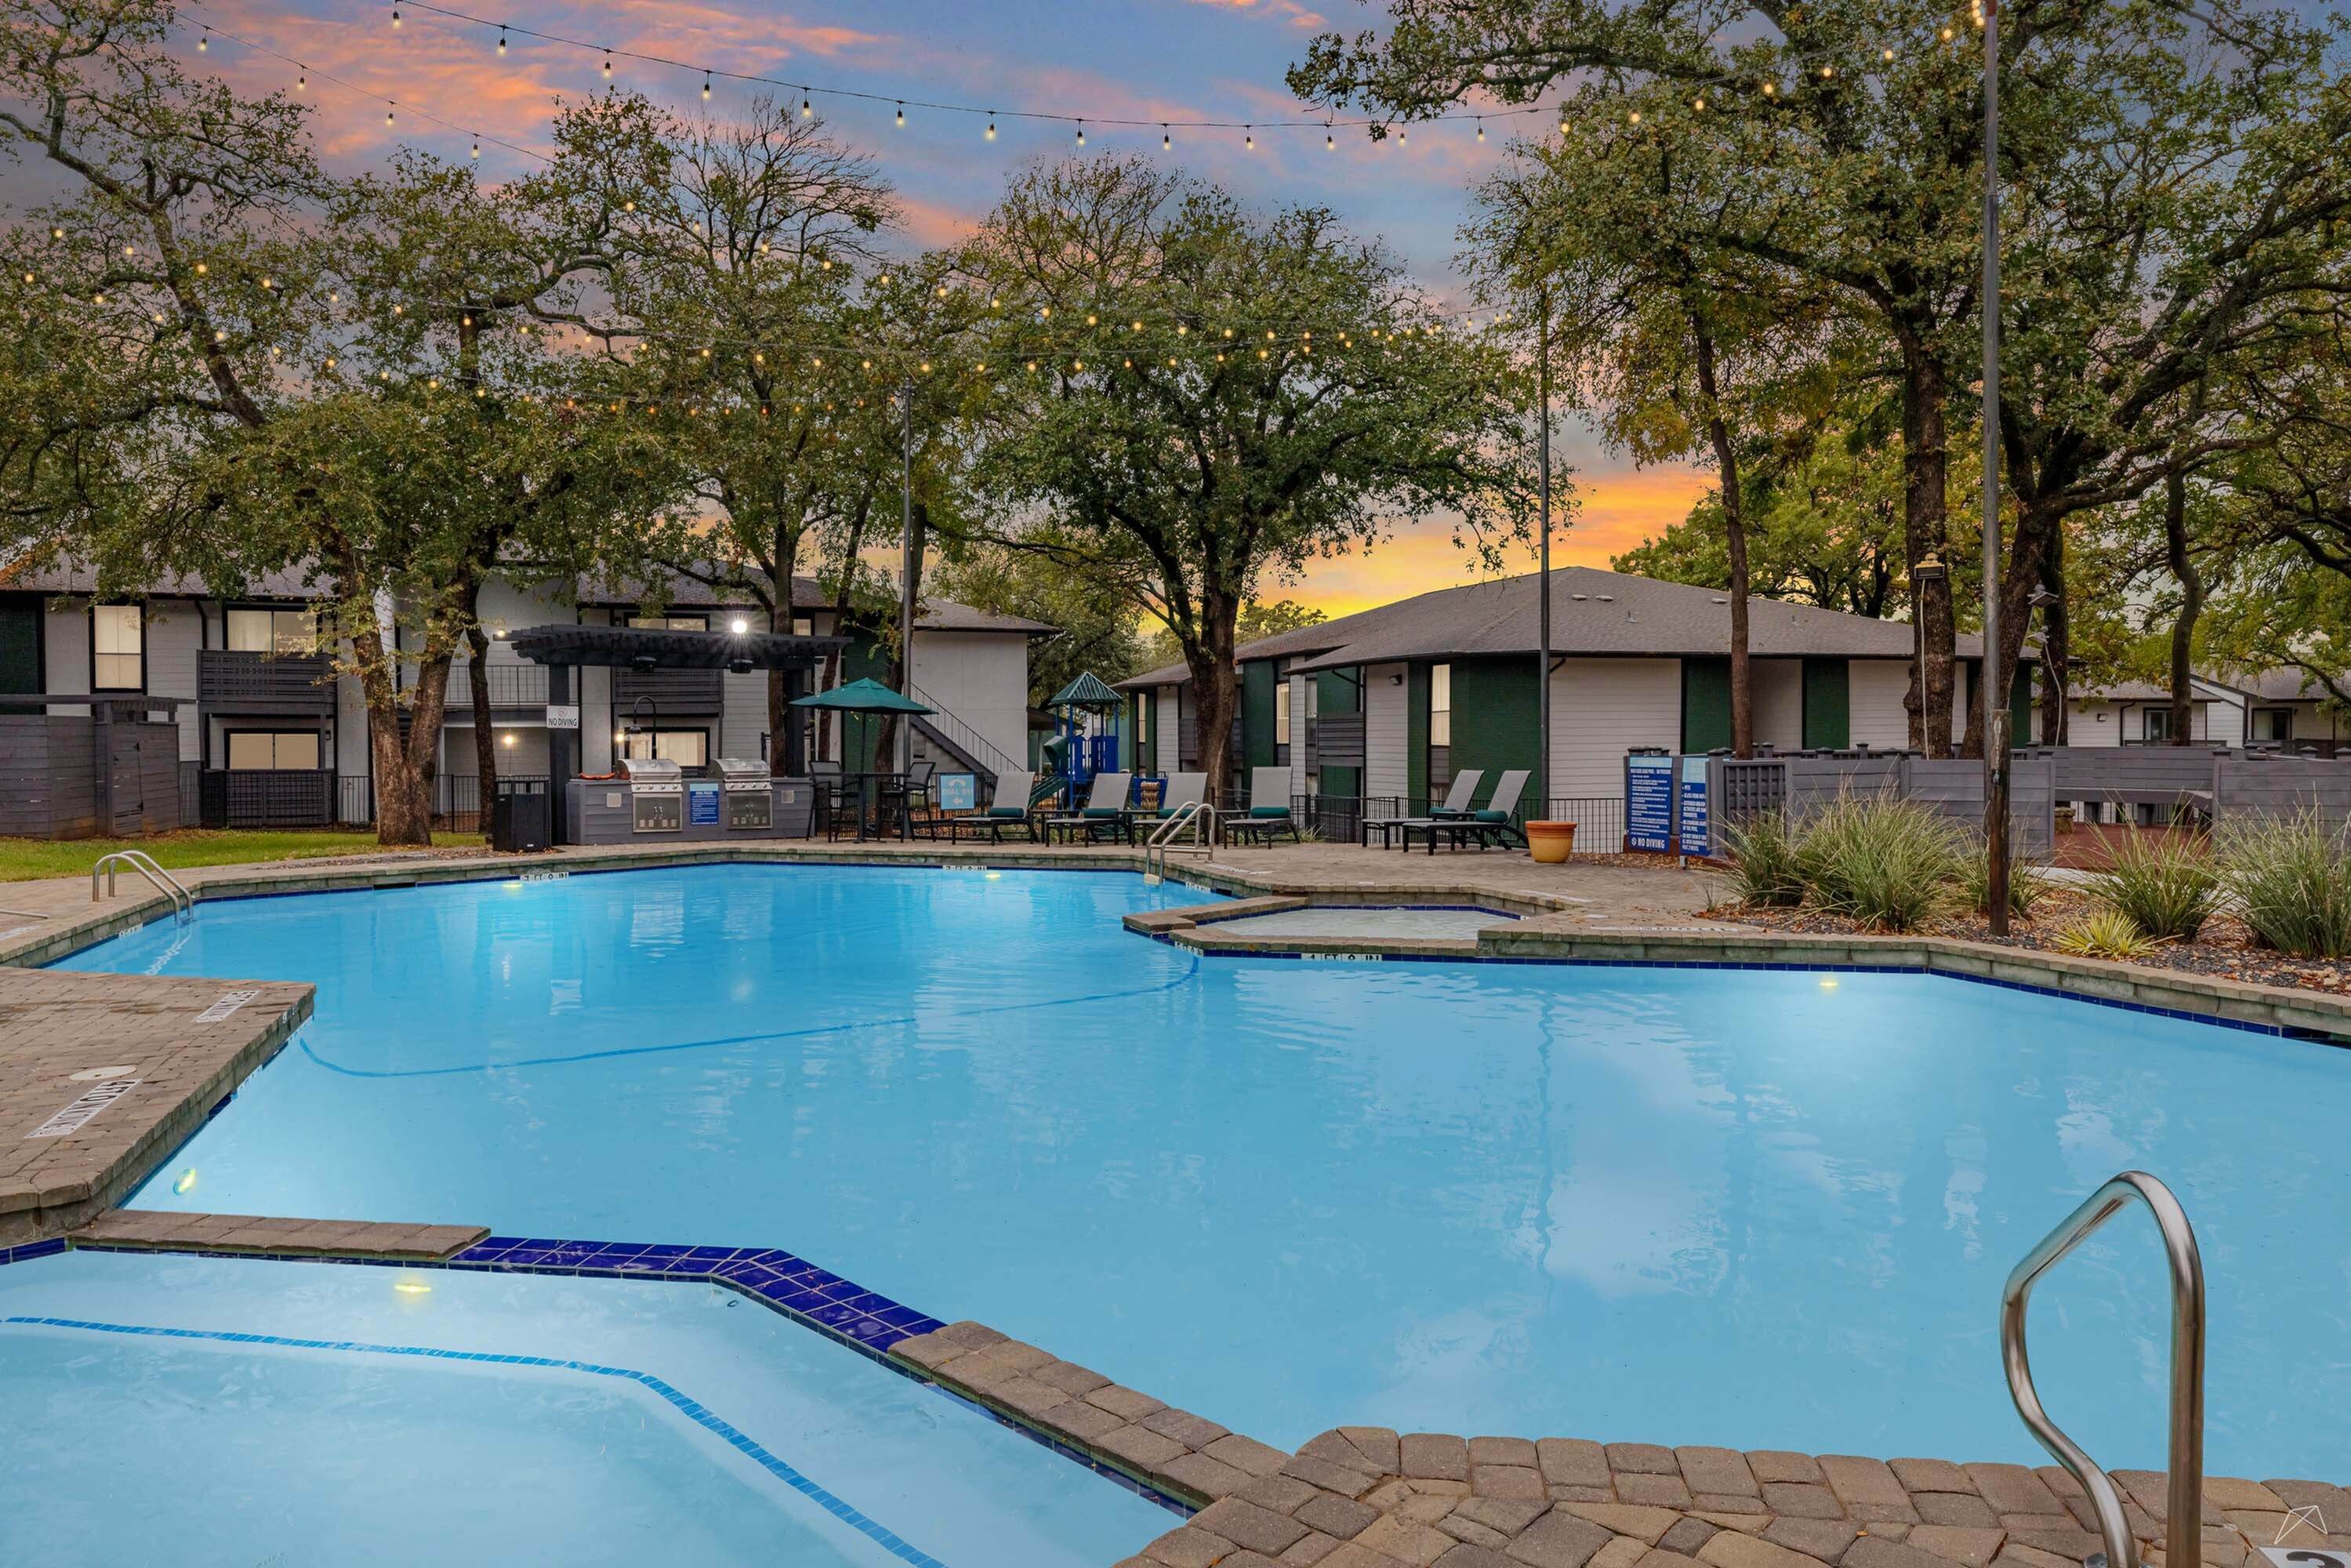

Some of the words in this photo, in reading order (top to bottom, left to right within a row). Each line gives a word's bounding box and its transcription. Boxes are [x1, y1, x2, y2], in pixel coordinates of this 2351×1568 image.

[549, 717, 557, 726] NO
[558, 717, 577, 727] DIVING
[1638, 837, 1645, 846] NO
[1646, 838, 1665, 849] DIVING
